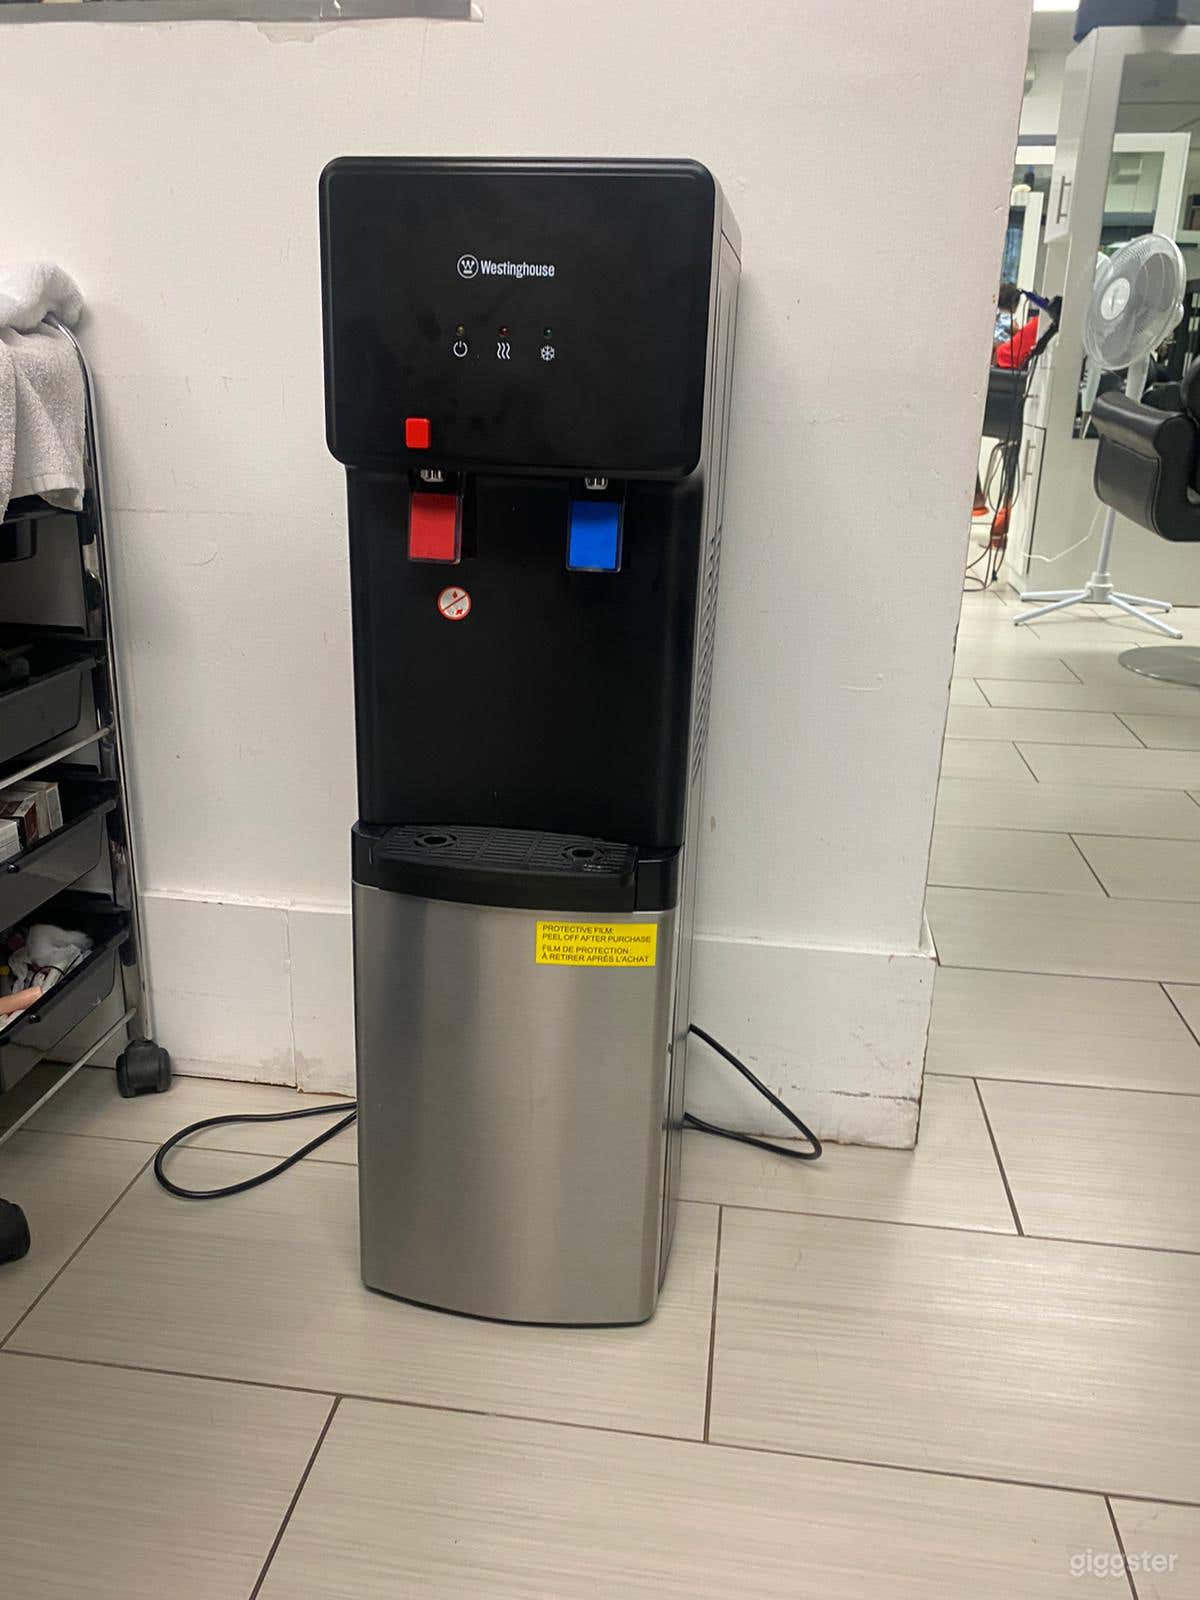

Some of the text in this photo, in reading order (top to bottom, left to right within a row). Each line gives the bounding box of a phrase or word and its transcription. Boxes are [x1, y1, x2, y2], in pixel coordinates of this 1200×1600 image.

[480, 259, 555, 279] Westinghouse
[542, 924, 593, 934] PROTECTIVE
[542, 933, 651, 943] PEEL OFF AFTER PURCHASE
[542, 945, 560, 953] FILM
[549, 953, 585, 962] RETIRER
[615, 955, 649, 963] L'ACHAT
